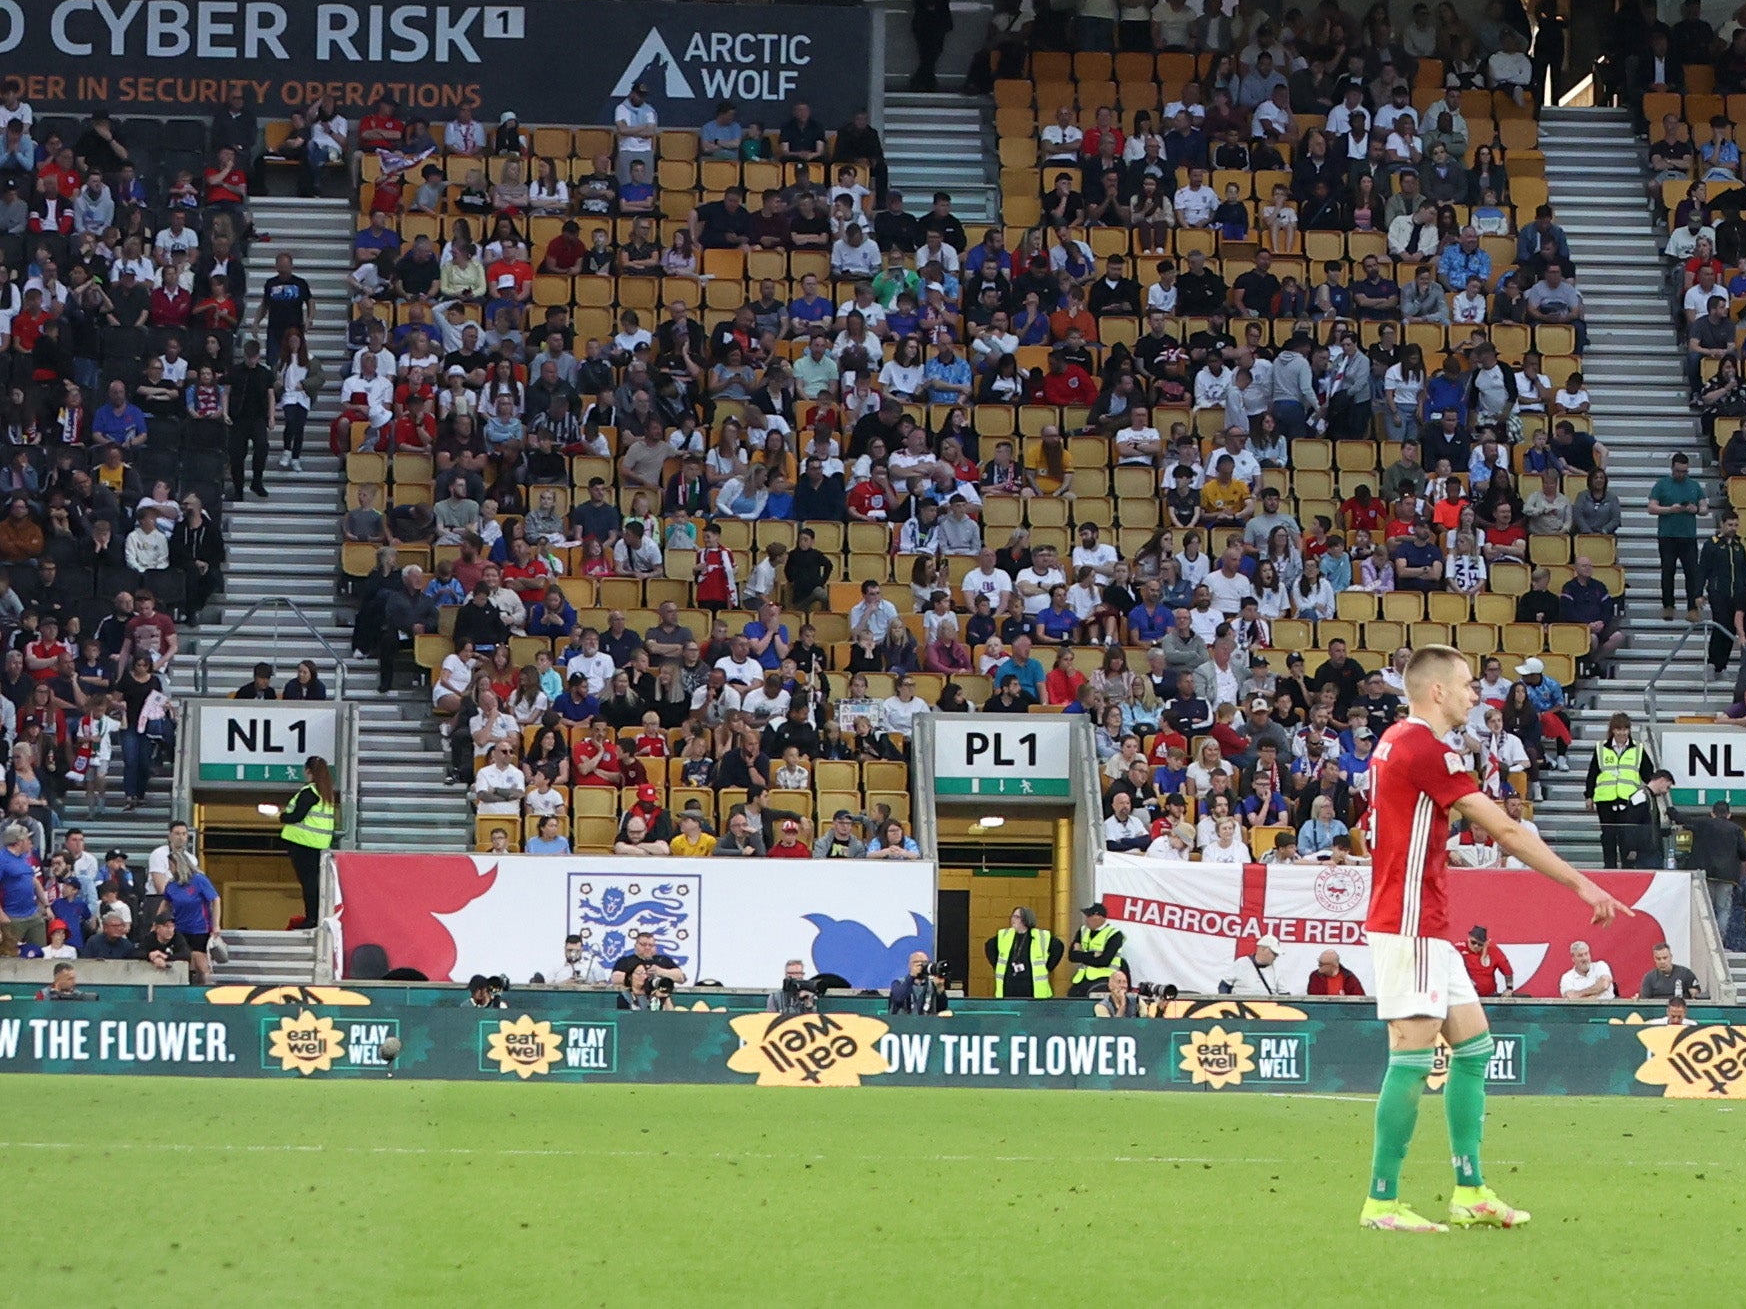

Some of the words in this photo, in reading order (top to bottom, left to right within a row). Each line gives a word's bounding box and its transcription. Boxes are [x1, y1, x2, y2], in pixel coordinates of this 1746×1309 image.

[495, 9, 511, 35] 1
[316, 3, 483, 64] RISK
[683, 32, 812, 66] ARCTIC
[77, 76, 109, 102] IN
[118, 77, 272, 104] SECURITY
[280, 80, 483, 109] OPERATIONS
[700, 68, 799, 101] WOLF
[226, 718, 307, 754] NL1
[966, 732, 1037, 767] PL1
[1123, 897, 1298, 942] HARROGATE
[29, 1019, 90, 1061] THE
[100, 1021, 237, 1063] FLOWER.
[286, 1026, 319, 1042] eat
[350, 1024, 390, 1044] PLAY
[505, 1029, 540, 1044] eat
[568, 1027, 608, 1048] PLAY
[287, 1038, 328, 1056] well
[506, 1042, 546, 1058] well
[566, 1047, 608, 1068] WELL
[940, 1034, 1000, 1075] THE
[1010, 1035, 1146, 1076] FLOWER.
[1197, 1041, 1232, 1056] eat
[1261, 1039, 1299, 1058] PLAY
[1198, 1053, 1238, 1069] well
[1259, 1058, 1301, 1079] WELL
